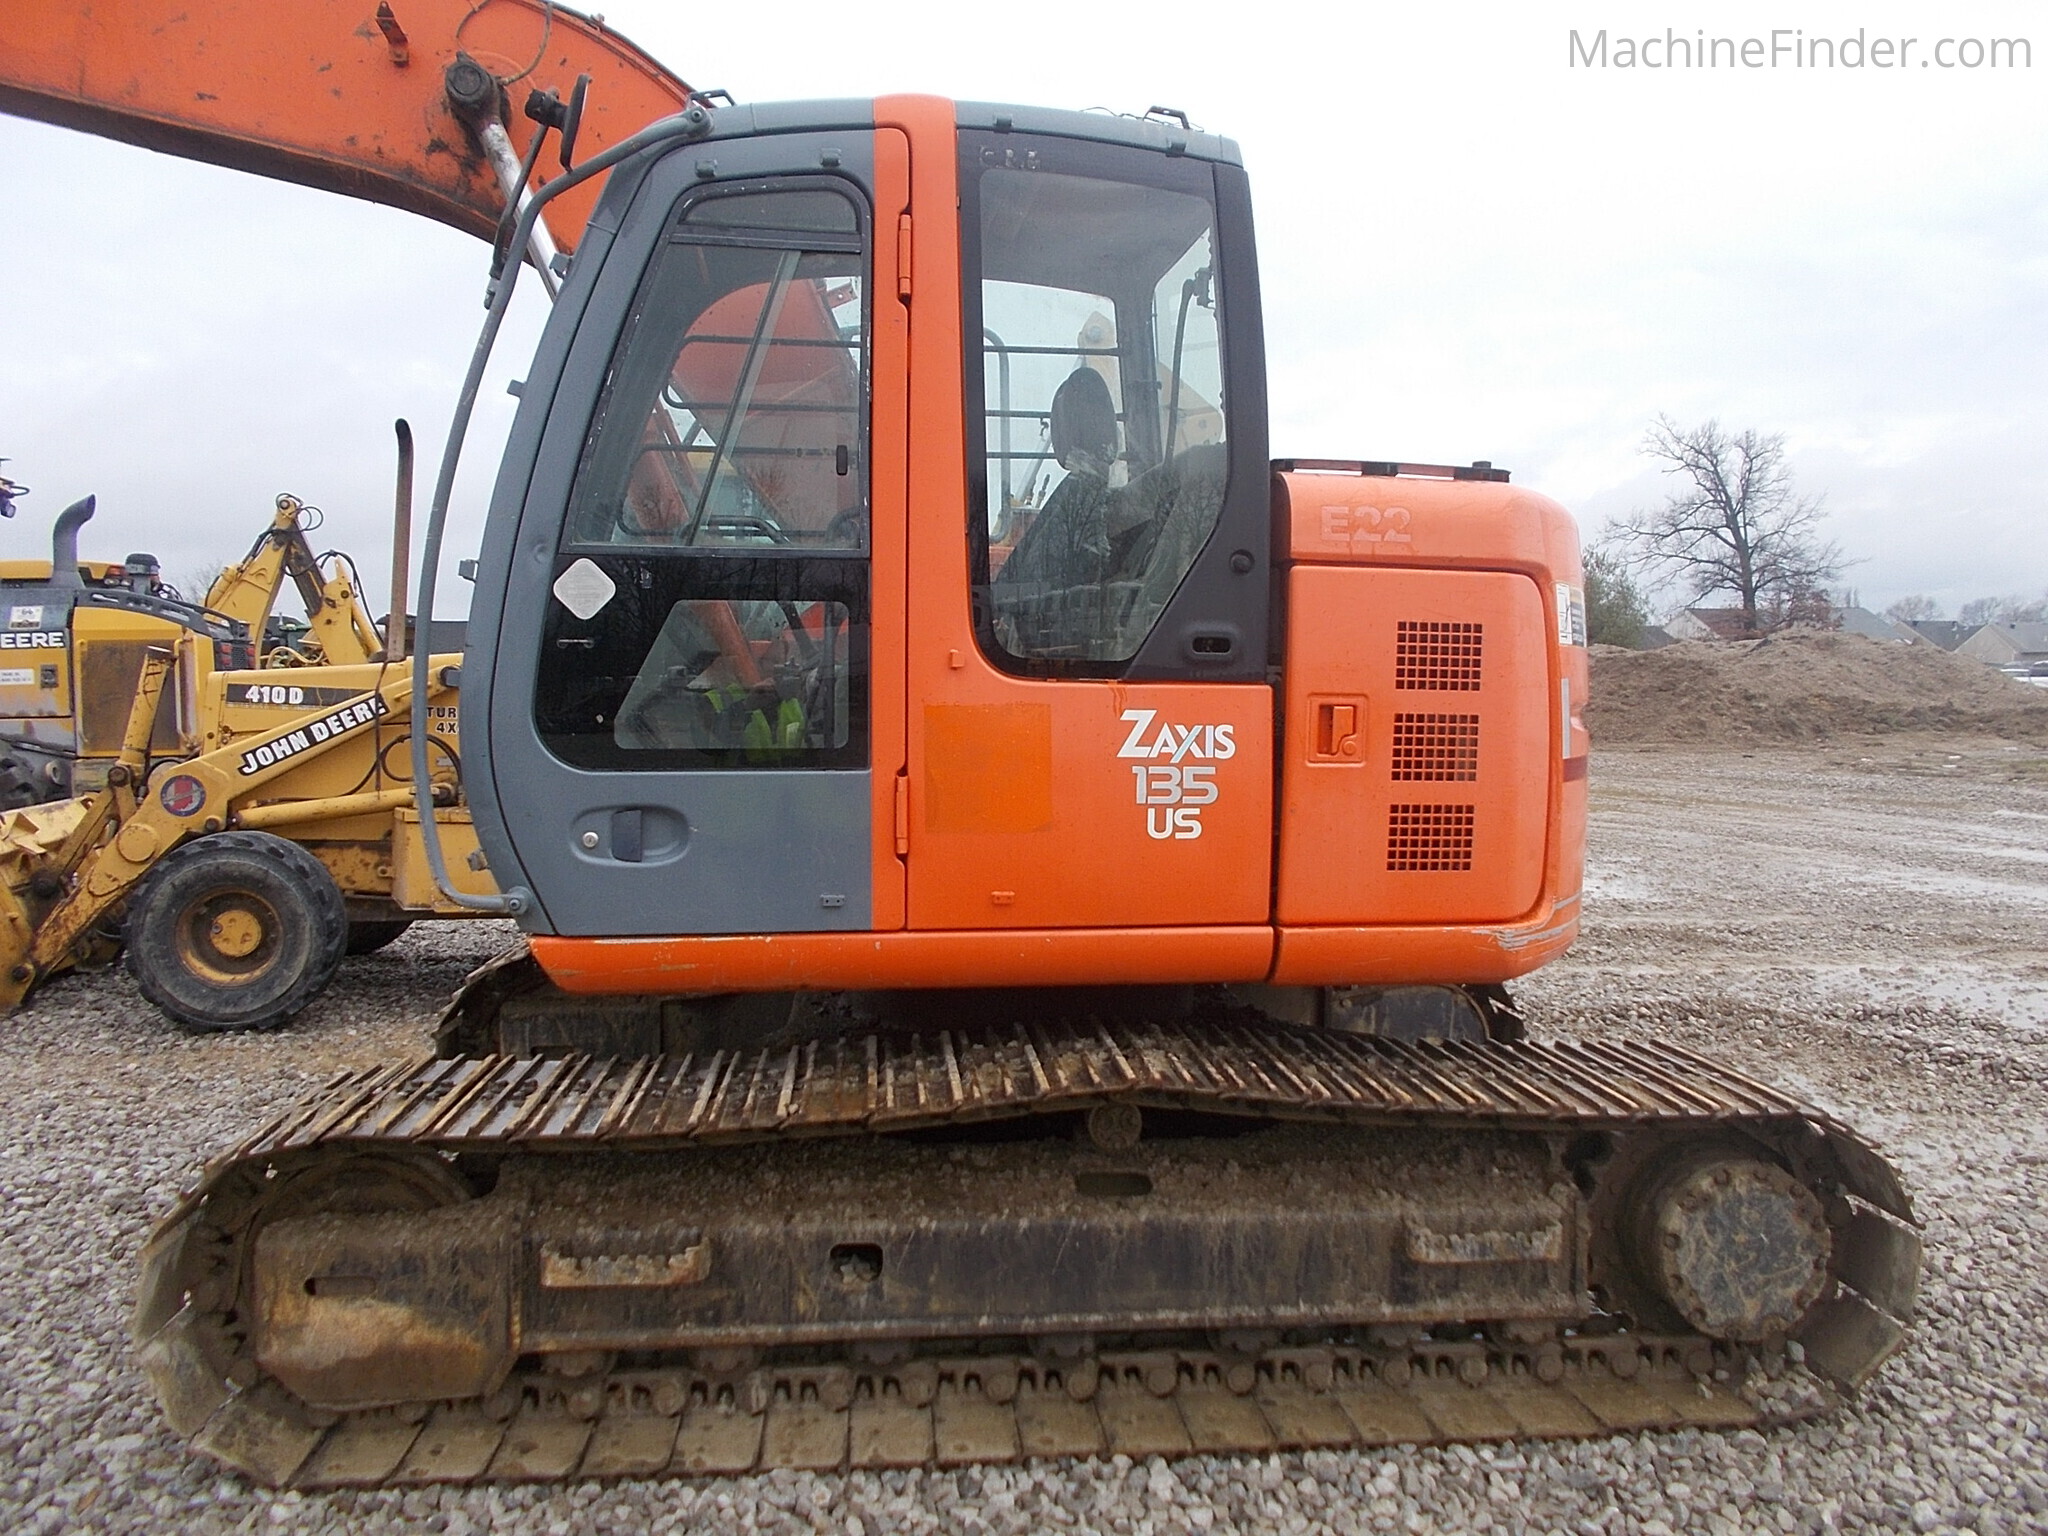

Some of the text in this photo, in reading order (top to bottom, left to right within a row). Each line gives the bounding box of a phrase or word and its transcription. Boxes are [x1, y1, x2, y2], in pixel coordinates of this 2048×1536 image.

[1321, 505, 1411, 542] E22
[0, 632, 64, 649] EERE
[242, 697, 386, 774] JOHN DEERE
[436, 721, 460, 734] 4X
[1116, 709, 1236, 764] ZAXIS
[1132, 765, 1219, 805] 135
[1147, 807, 1202, 839] US
